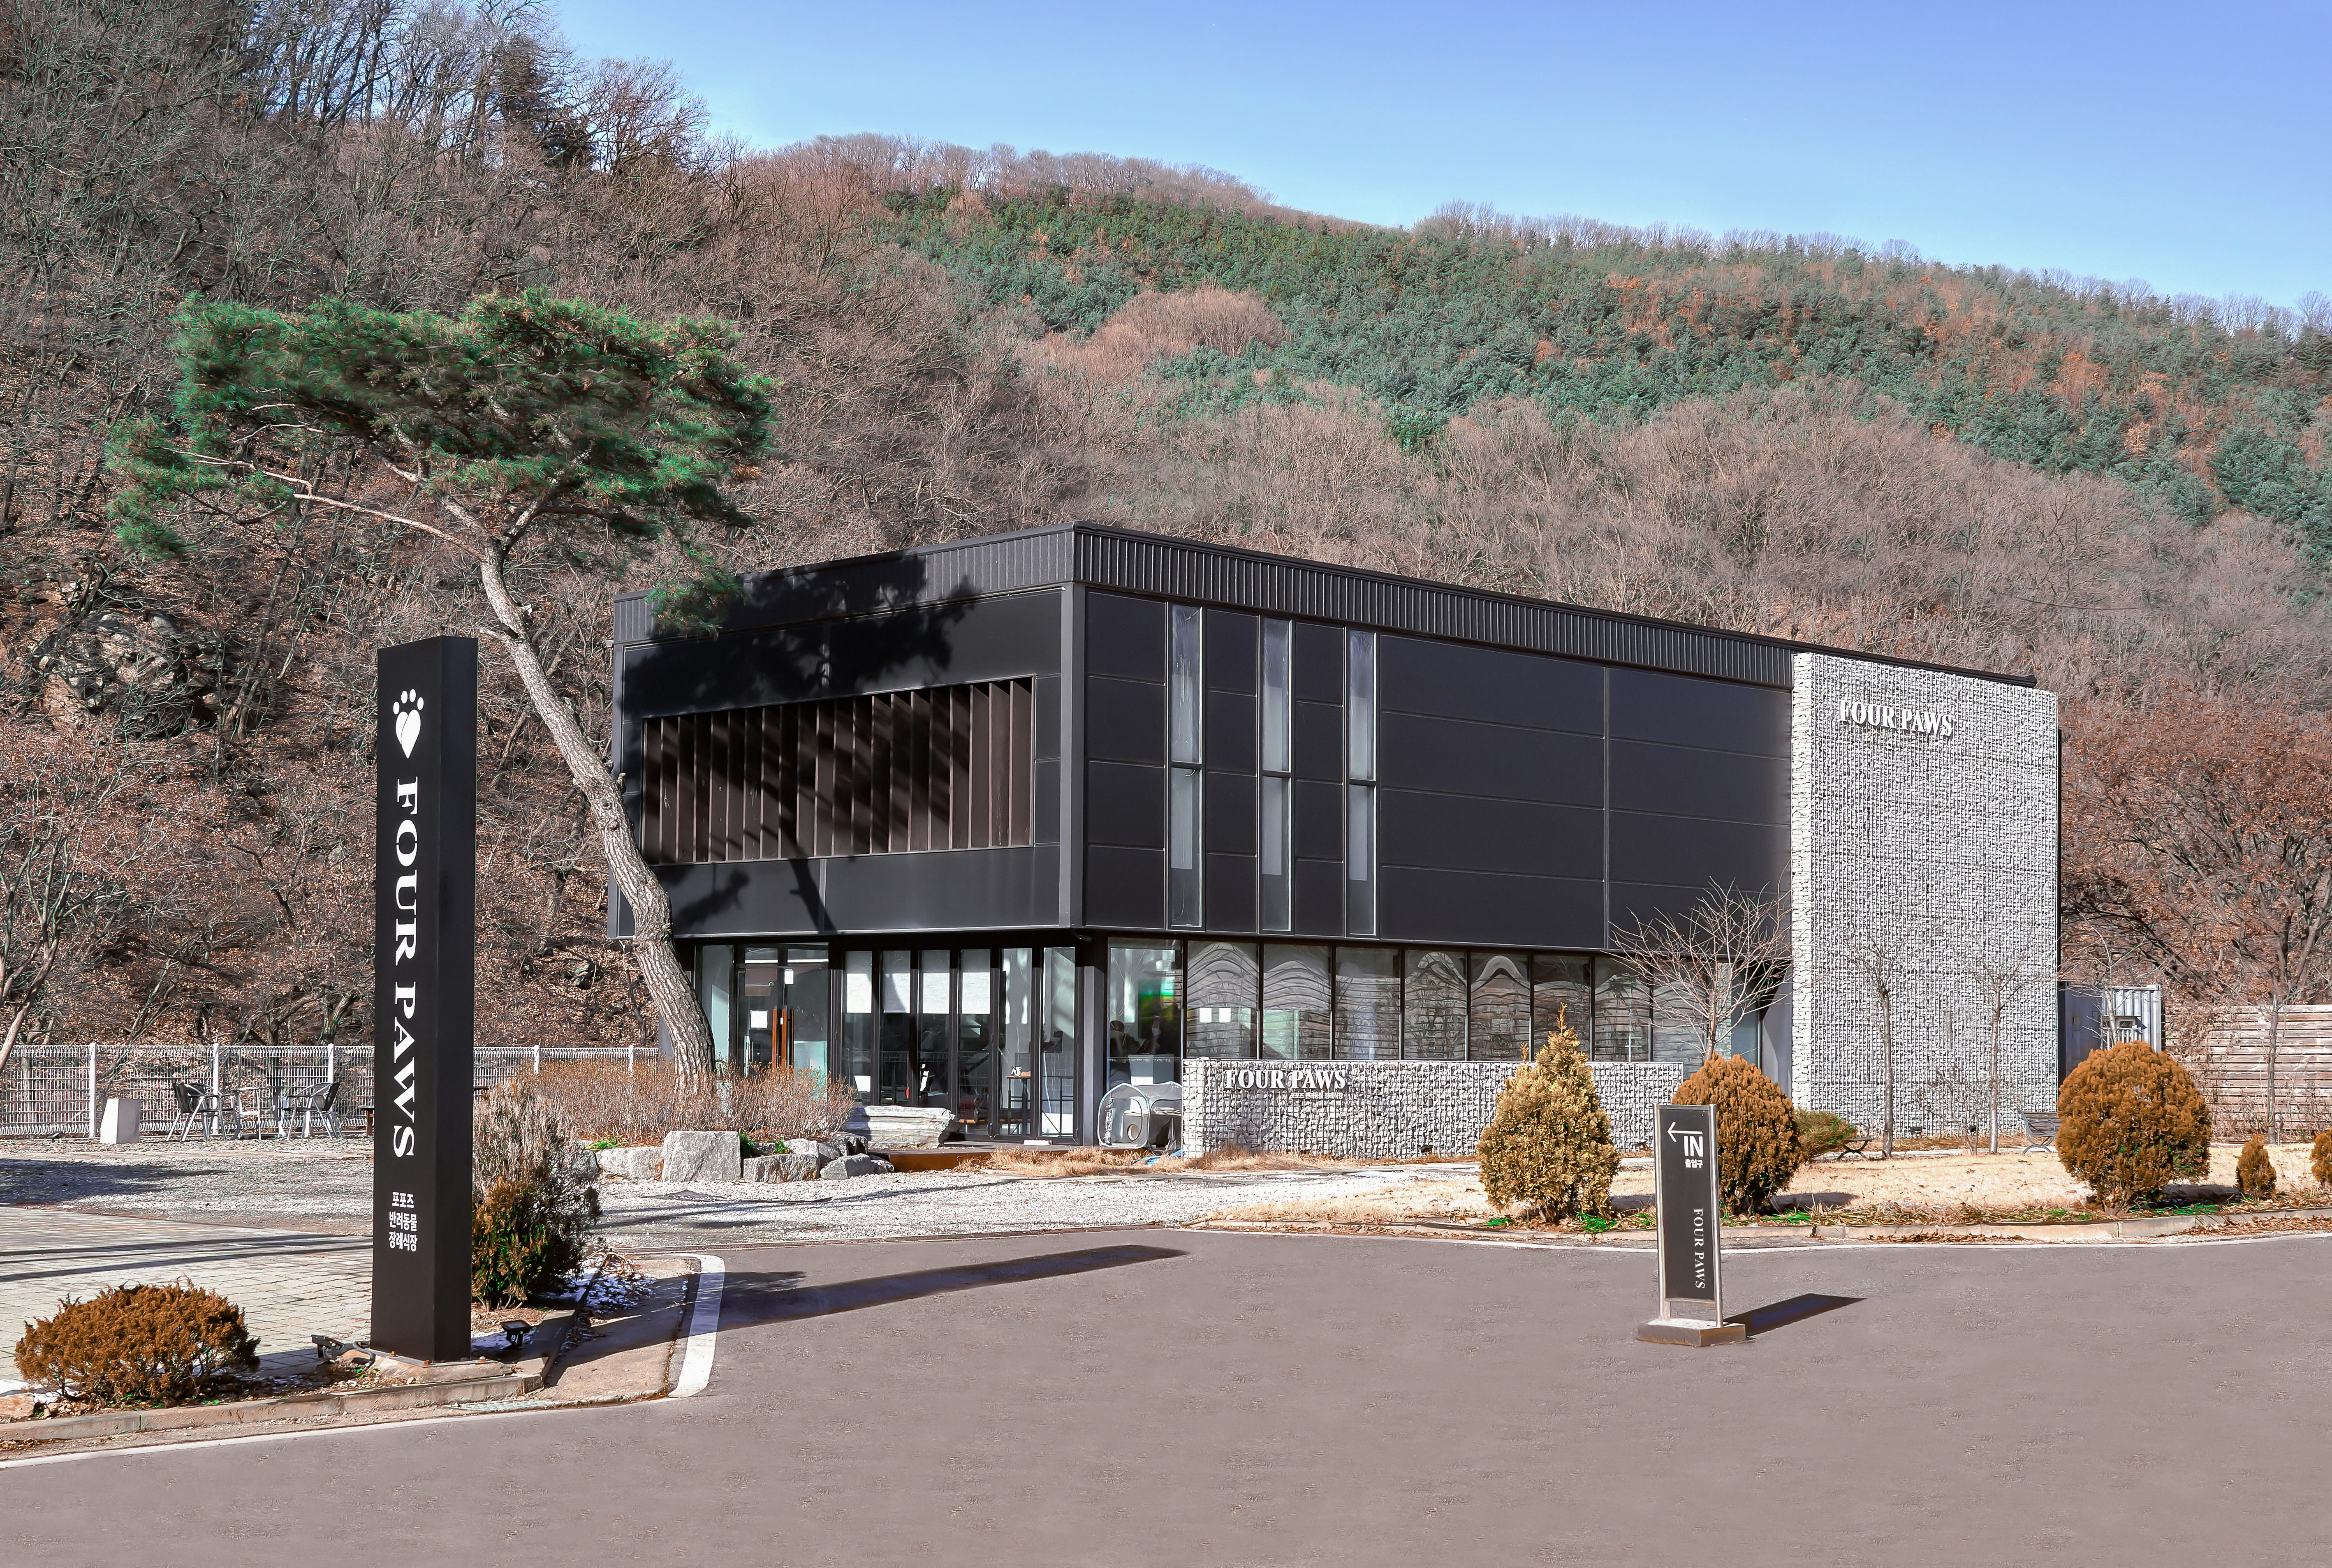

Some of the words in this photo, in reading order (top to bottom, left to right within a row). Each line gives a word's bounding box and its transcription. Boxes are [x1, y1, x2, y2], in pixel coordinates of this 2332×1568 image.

[1839, 700, 1896, 728] FOUR
[1899, 709, 1954, 737] PAWS
[396, 776, 418, 966] FOUR
[393, 981, 416, 1158] PAWS
[1224, 1069, 1285, 1089] FOUR
[1292, 1069, 1345, 1089] PAWS
[1684, 1136, 1704, 1157] IN
[1684, 1159, 1704, 1168] 출입구
[392, 1191, 415, 1208] 포포즈
[389, 1211, 417, 1231] 반려동물
[1693, 1208, 1704, 1247] FOUR
[389, 1231, 418, 1252] 장례식장
[1695, 1251, 1706, 1289] PAWS
